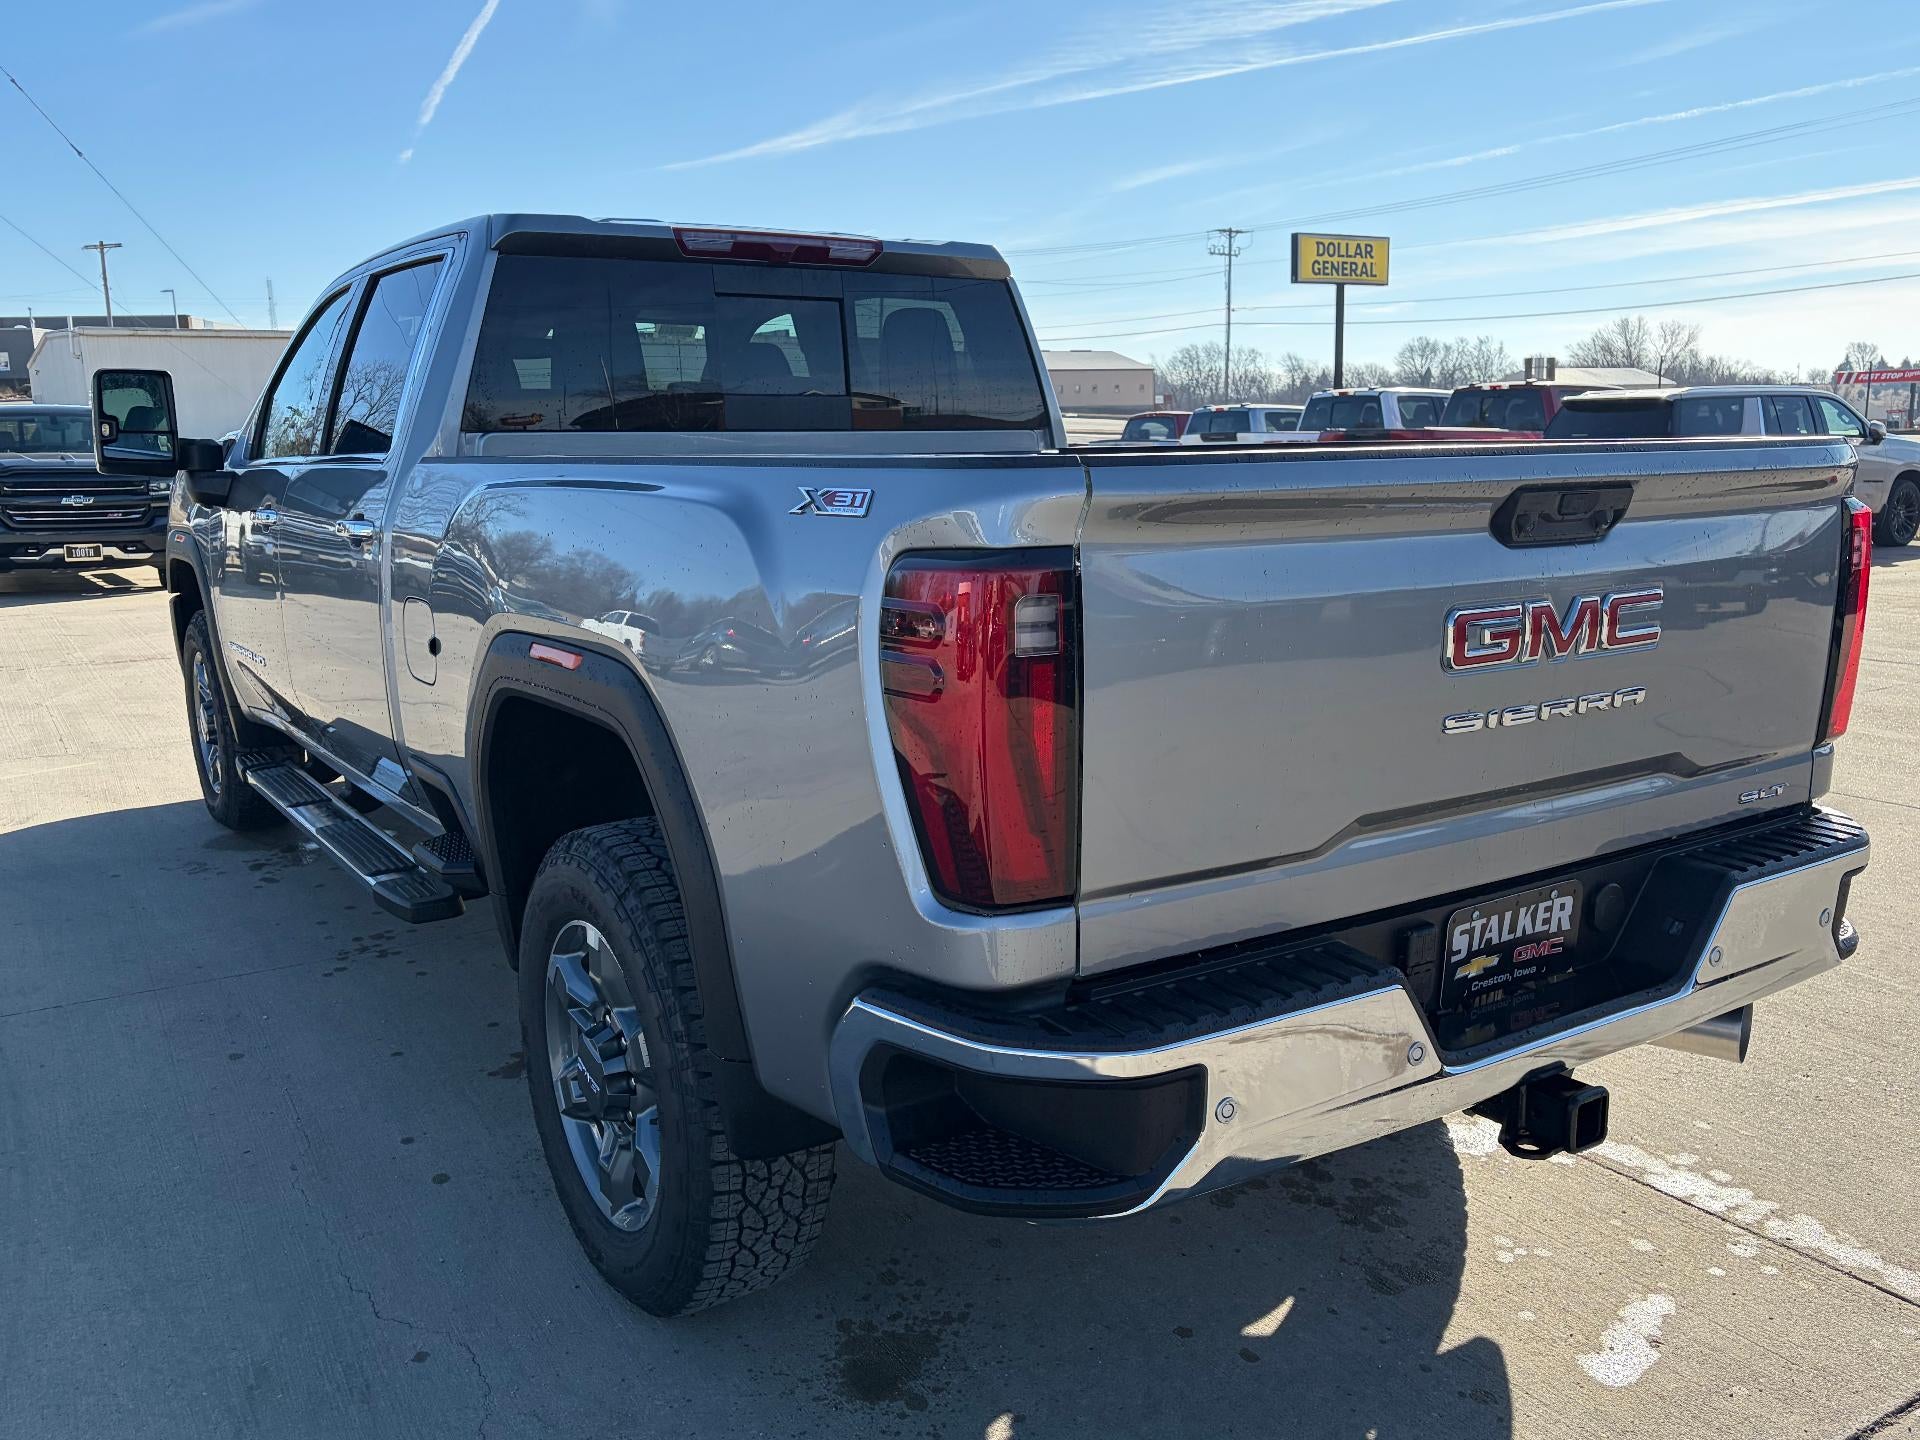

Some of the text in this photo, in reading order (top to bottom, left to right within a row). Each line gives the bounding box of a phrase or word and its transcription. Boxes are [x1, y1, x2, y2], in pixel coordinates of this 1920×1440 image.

[1316, 241, 1374, 259] DOLLAR
[1312, 259, 1377, 278] GENERAL
[1858, 372, 1880, 380] FAST
[1880, 372, 1903, 380] STOP
[1443, 587, 1663, 674] GMC
[1442, 686, 1646, 734] SIERRA
[1738, 782, 1790, 804] SLT
[1450, 896, 1574, 964] STALKER
[1513, 937, 1564, 963] GMC
[1471, 965, 1537, 991] Creston, Iowa
